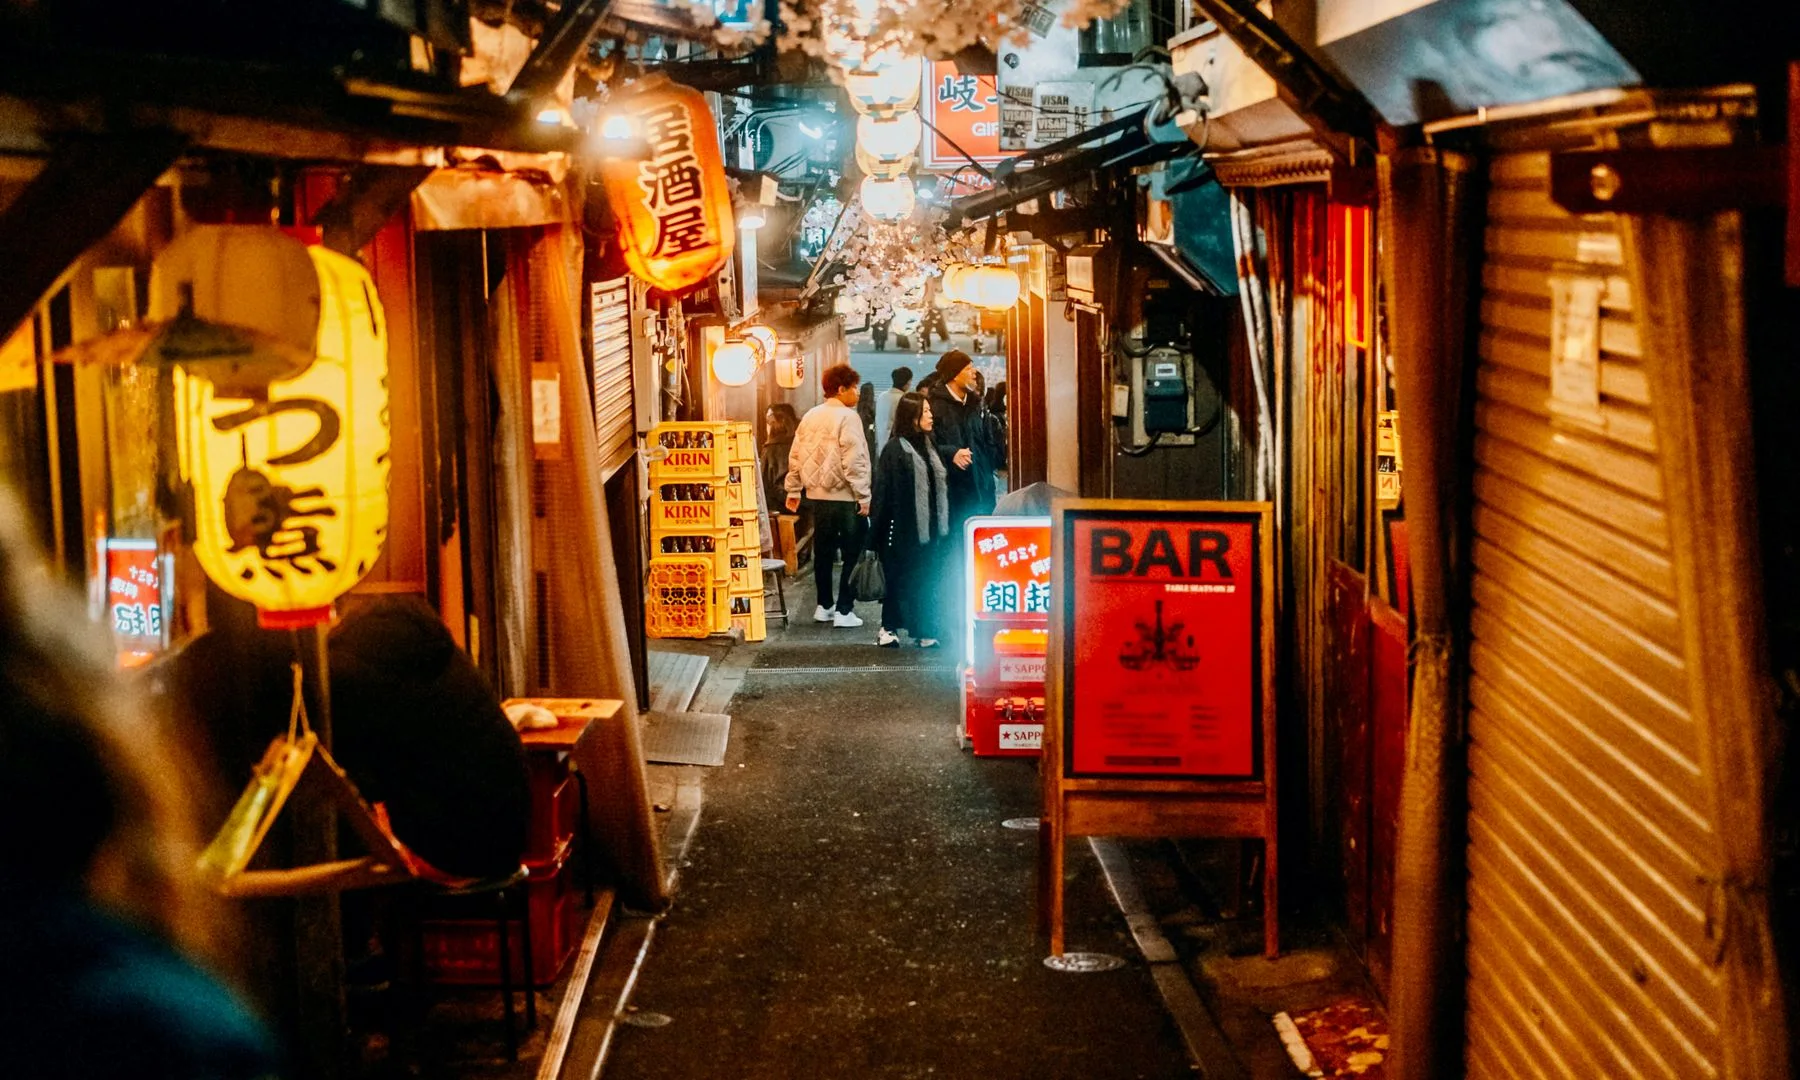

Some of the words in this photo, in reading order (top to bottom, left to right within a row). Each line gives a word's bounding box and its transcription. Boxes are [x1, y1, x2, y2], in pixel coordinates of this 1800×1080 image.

[939, 73, 998, 111] 岐
[663, 453, 710, 466] KIRIN
[664, 505, 710, 518] KIRIN
[1090, 528, 1233, 578] BAR
